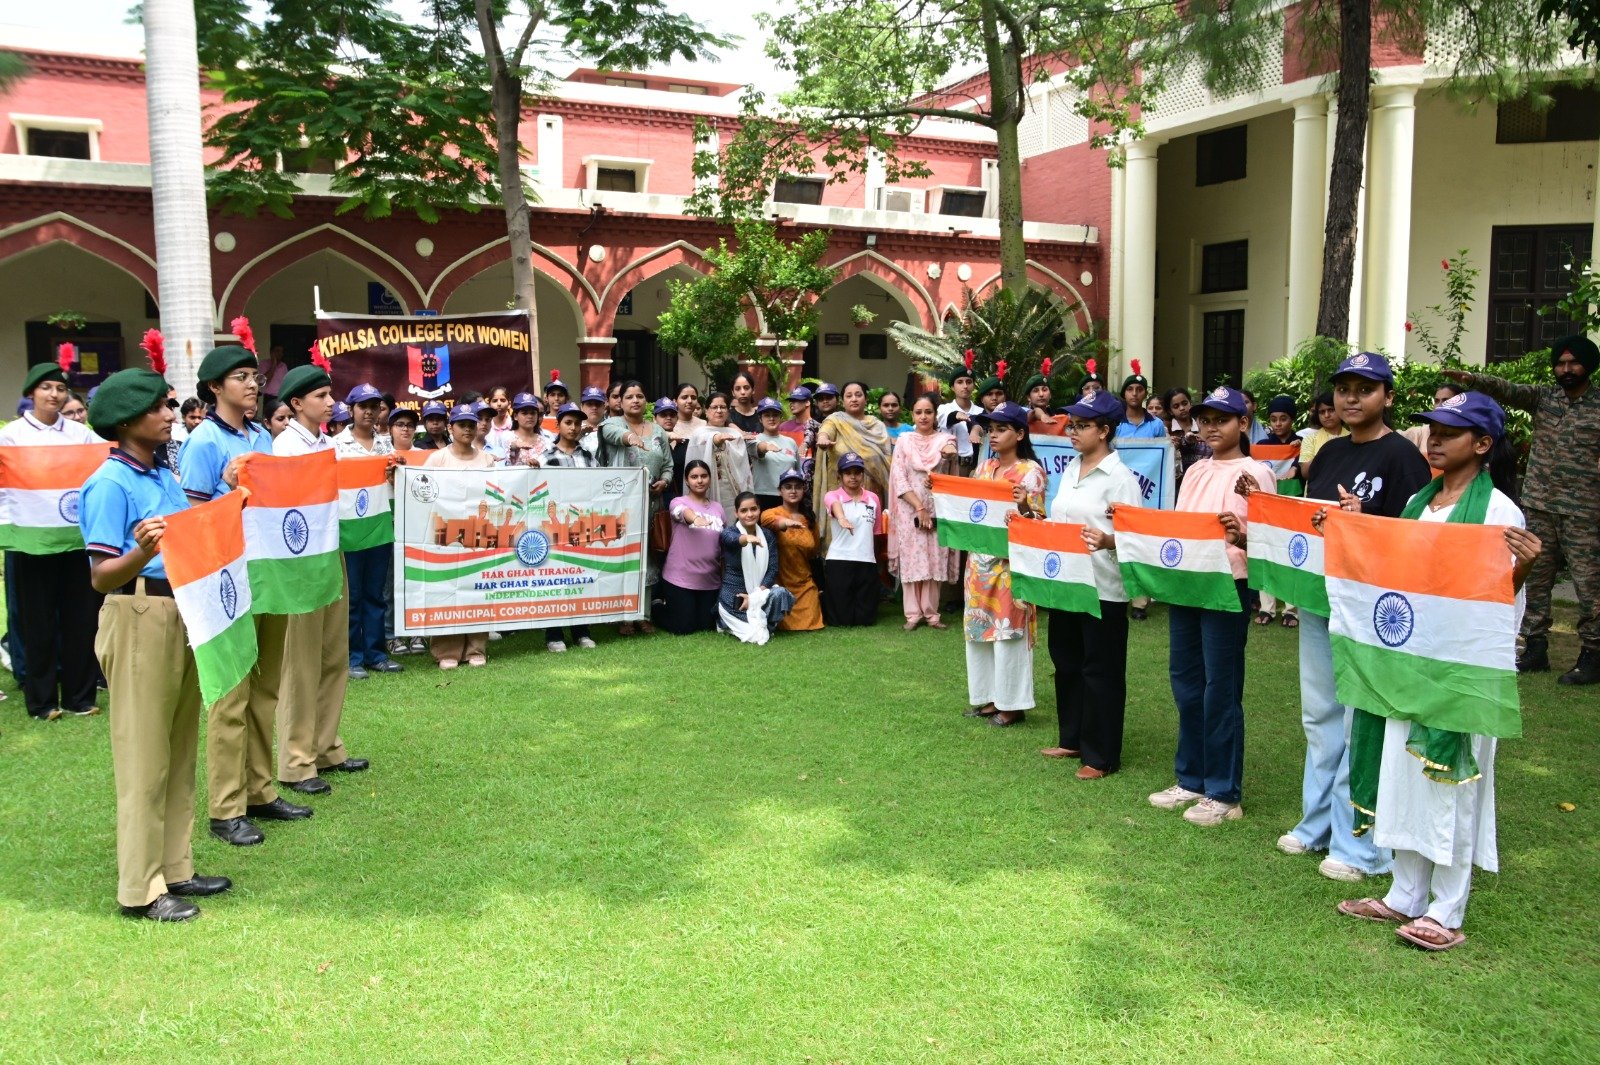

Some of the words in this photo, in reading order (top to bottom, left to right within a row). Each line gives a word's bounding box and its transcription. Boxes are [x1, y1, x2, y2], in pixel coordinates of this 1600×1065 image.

[318, 328, 378, 358] KHALSA
[379, 323, 443, 345] COLLEGE
[447, 323, 476, 343] FOR
[477, 326, 529, 353] WOMEN
[481, 571, 504, 579] HAR
[507, 569, 535, 578] GHAR
[500, 580, 528, 588] GHAR
[531, 577, 594, 587] SWACHHATA
[485, 589, 562, 600] INDEPENDENCE
[564, 587, 584, 596] DAY
[411, 613, 426, 622] BY
[499, 603, 576, 617] CORPORATION
[582, 599, 633, 611] LUDHIANA
